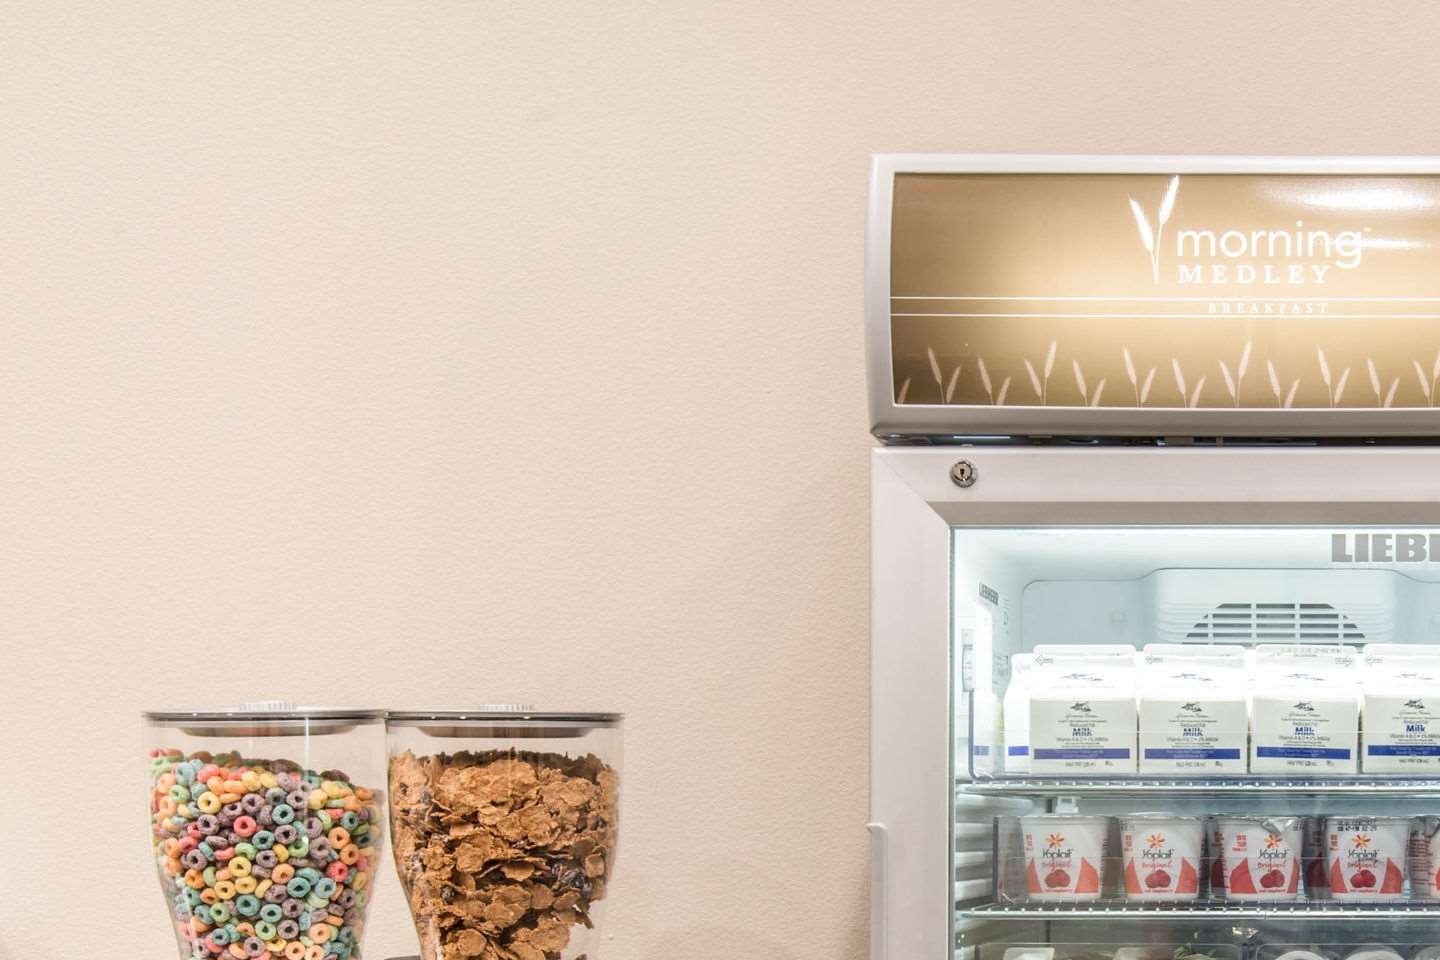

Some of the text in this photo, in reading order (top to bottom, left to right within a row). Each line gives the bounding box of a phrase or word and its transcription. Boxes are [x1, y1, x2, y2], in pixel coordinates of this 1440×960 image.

[1177, 221, 1362, 269] morning
[1178, 264, 1331, 284] MEDLEY
[1208, 302, 1329, 314] BREAKFAST
[1406, 724, 1425, 732] Milk
